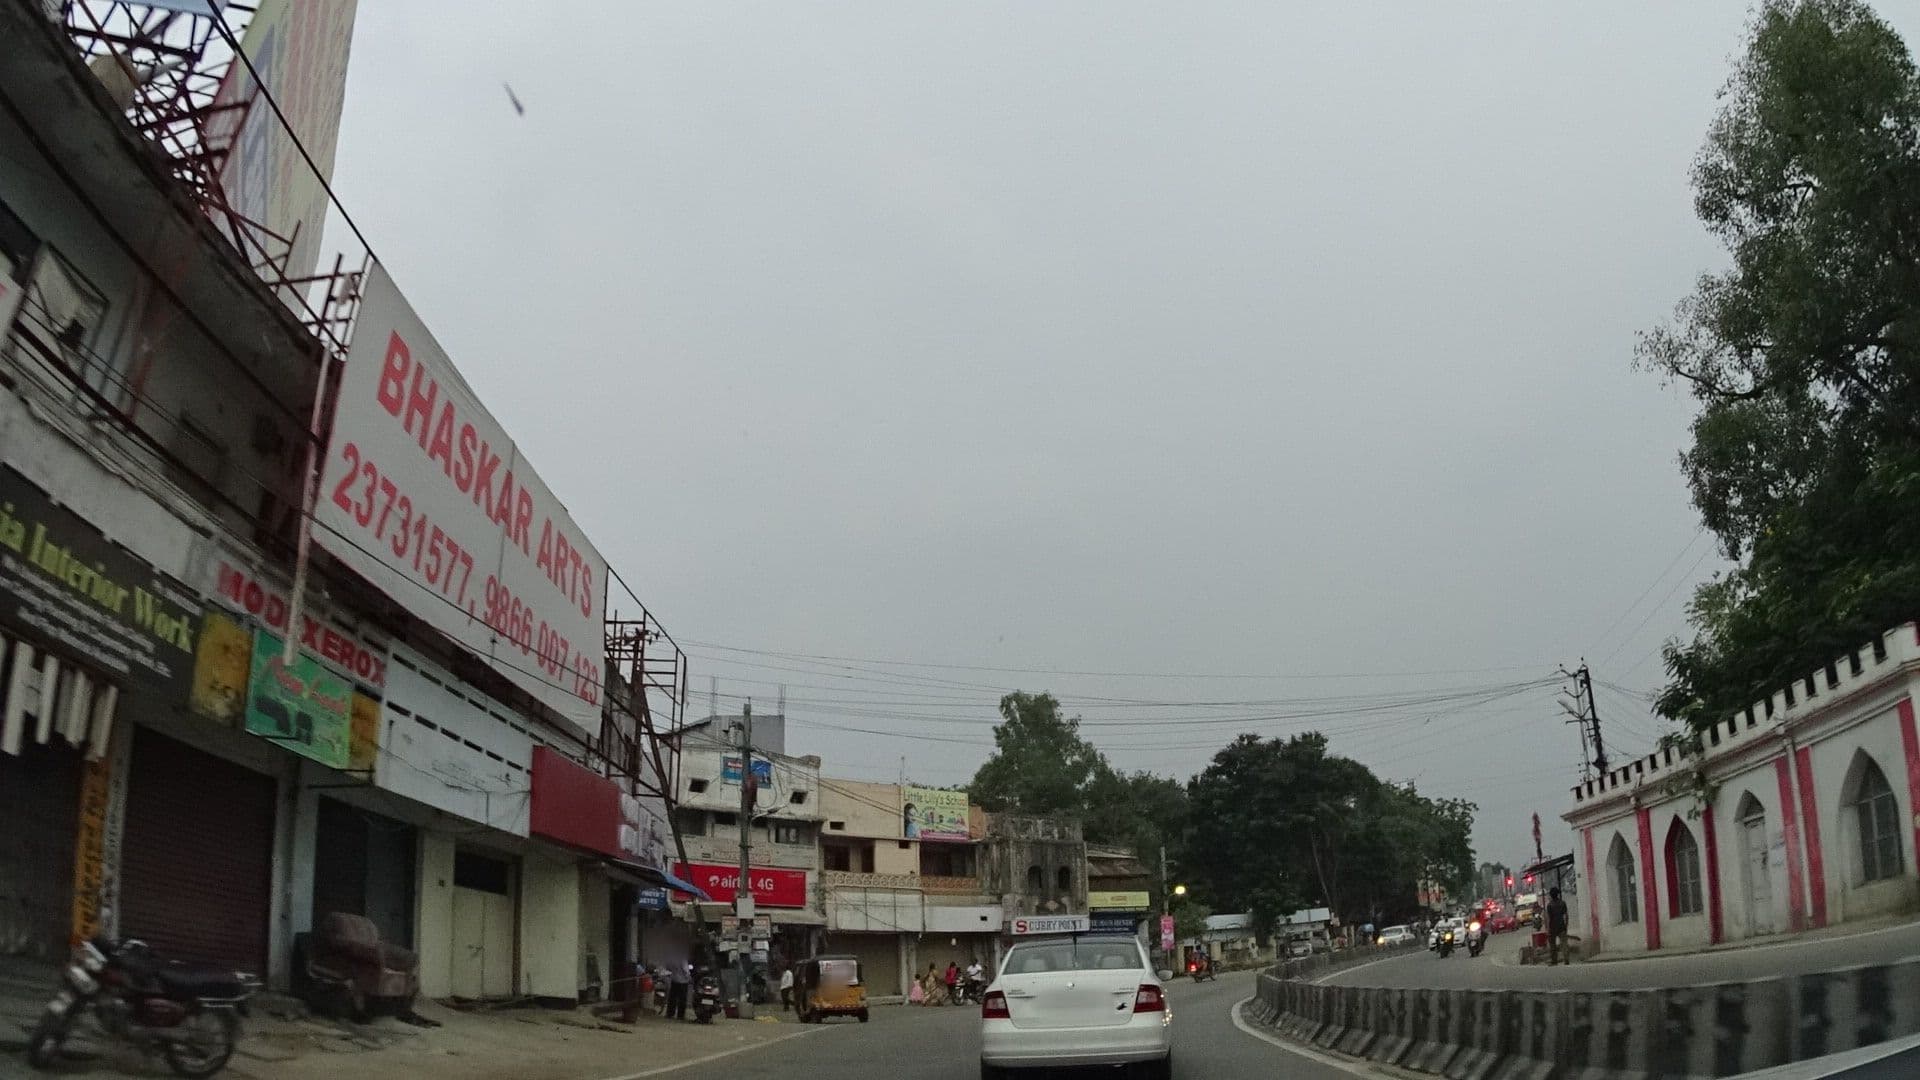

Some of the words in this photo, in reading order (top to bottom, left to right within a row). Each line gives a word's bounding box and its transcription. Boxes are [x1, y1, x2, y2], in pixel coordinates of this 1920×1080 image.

[377, 330, 532, 557] BHASKAR
[536, 518, 592, 618] ARTS
[28, 523, 129, 614] Interior
[134, 586, 194, 655] Work
[484, 574, 533, 655] 9866
[536, 620, 570, 681] 007
[573, 651, 599, 706] 123
[300, 614, 387, 687] XEROX
[720, 874, 753, 890] airtl
[757, 877, 774, 891] 4G
[1016, 920, 1028, 933] S
